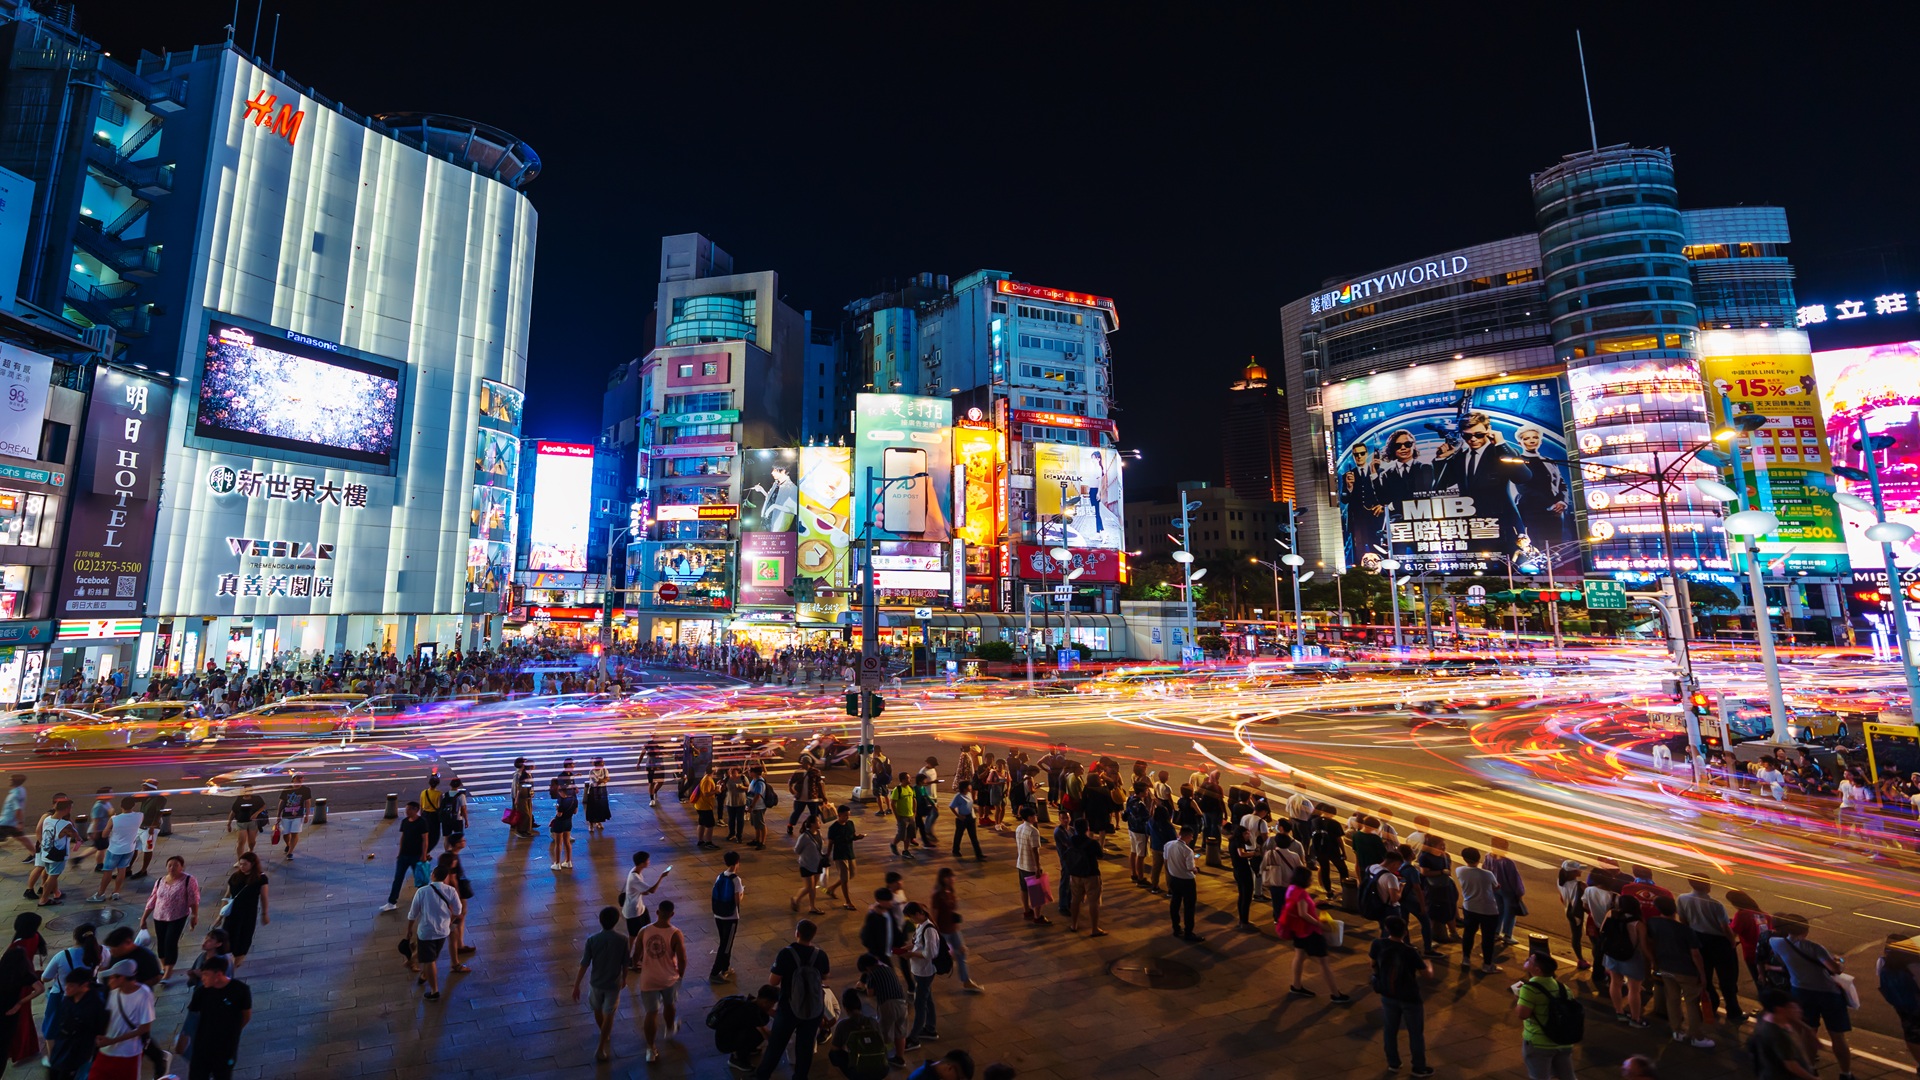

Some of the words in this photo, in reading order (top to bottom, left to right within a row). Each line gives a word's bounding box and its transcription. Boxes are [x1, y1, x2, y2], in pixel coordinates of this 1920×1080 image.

[242, 89, 305, 146] H&M
[1012, 283, 1031, 294] Diary
[1043, 289, 1064, 299] Taipei
[1332, 256, 1468, 307] PARTYWORLD
[286, 330, 338, 352] Panasonic
[1735, 379, 1786, 397] 15%
[124, 384, 149, 444] 明日
[541, 445, 566, 453] Apollo
[103, 449, 140, 548] HOTEL
[237, 468, 369, 508] 新世界大樓
[1802, 485, 1829, 497] 12%
[1402, 496, 1476, 520] MIB
[1813, 504, 1833, 517] 5%
[1390, 518, 1499, 542] 星際戰警
[73, 559, 142, 573] (02)2375-5500
[216, 573, 333, 598] 真善美劇院
[1590, 582, 1620, 590] 成都路
